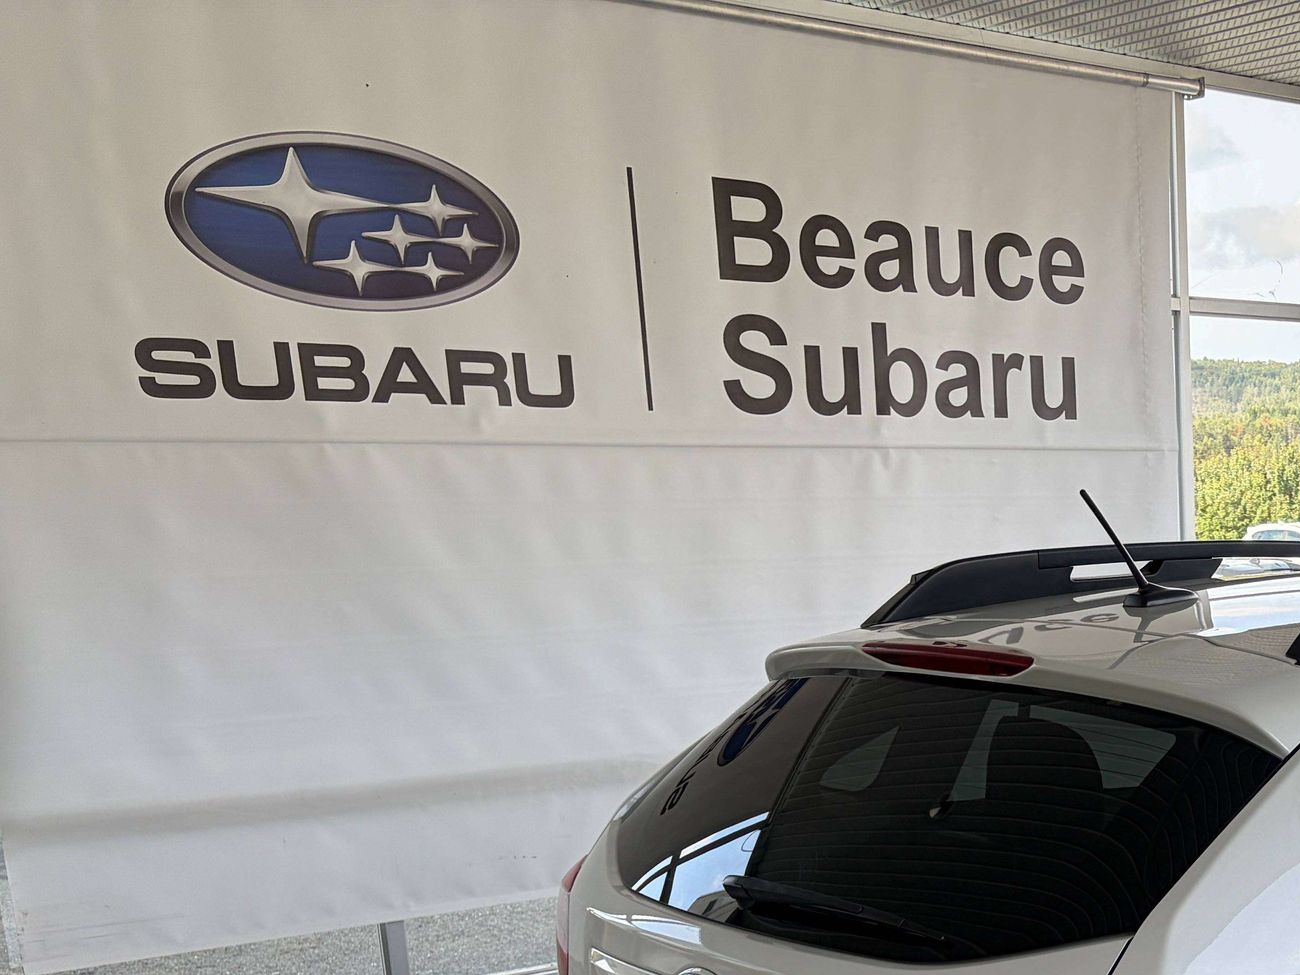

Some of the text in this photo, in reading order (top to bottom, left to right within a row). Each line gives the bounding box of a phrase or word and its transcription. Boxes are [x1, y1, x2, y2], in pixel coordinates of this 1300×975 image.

[711, 176, 1086, 305] Beauce
[134, 337, 575, 408] SUBARU
[722, 313, 1077, 421] Subaru
